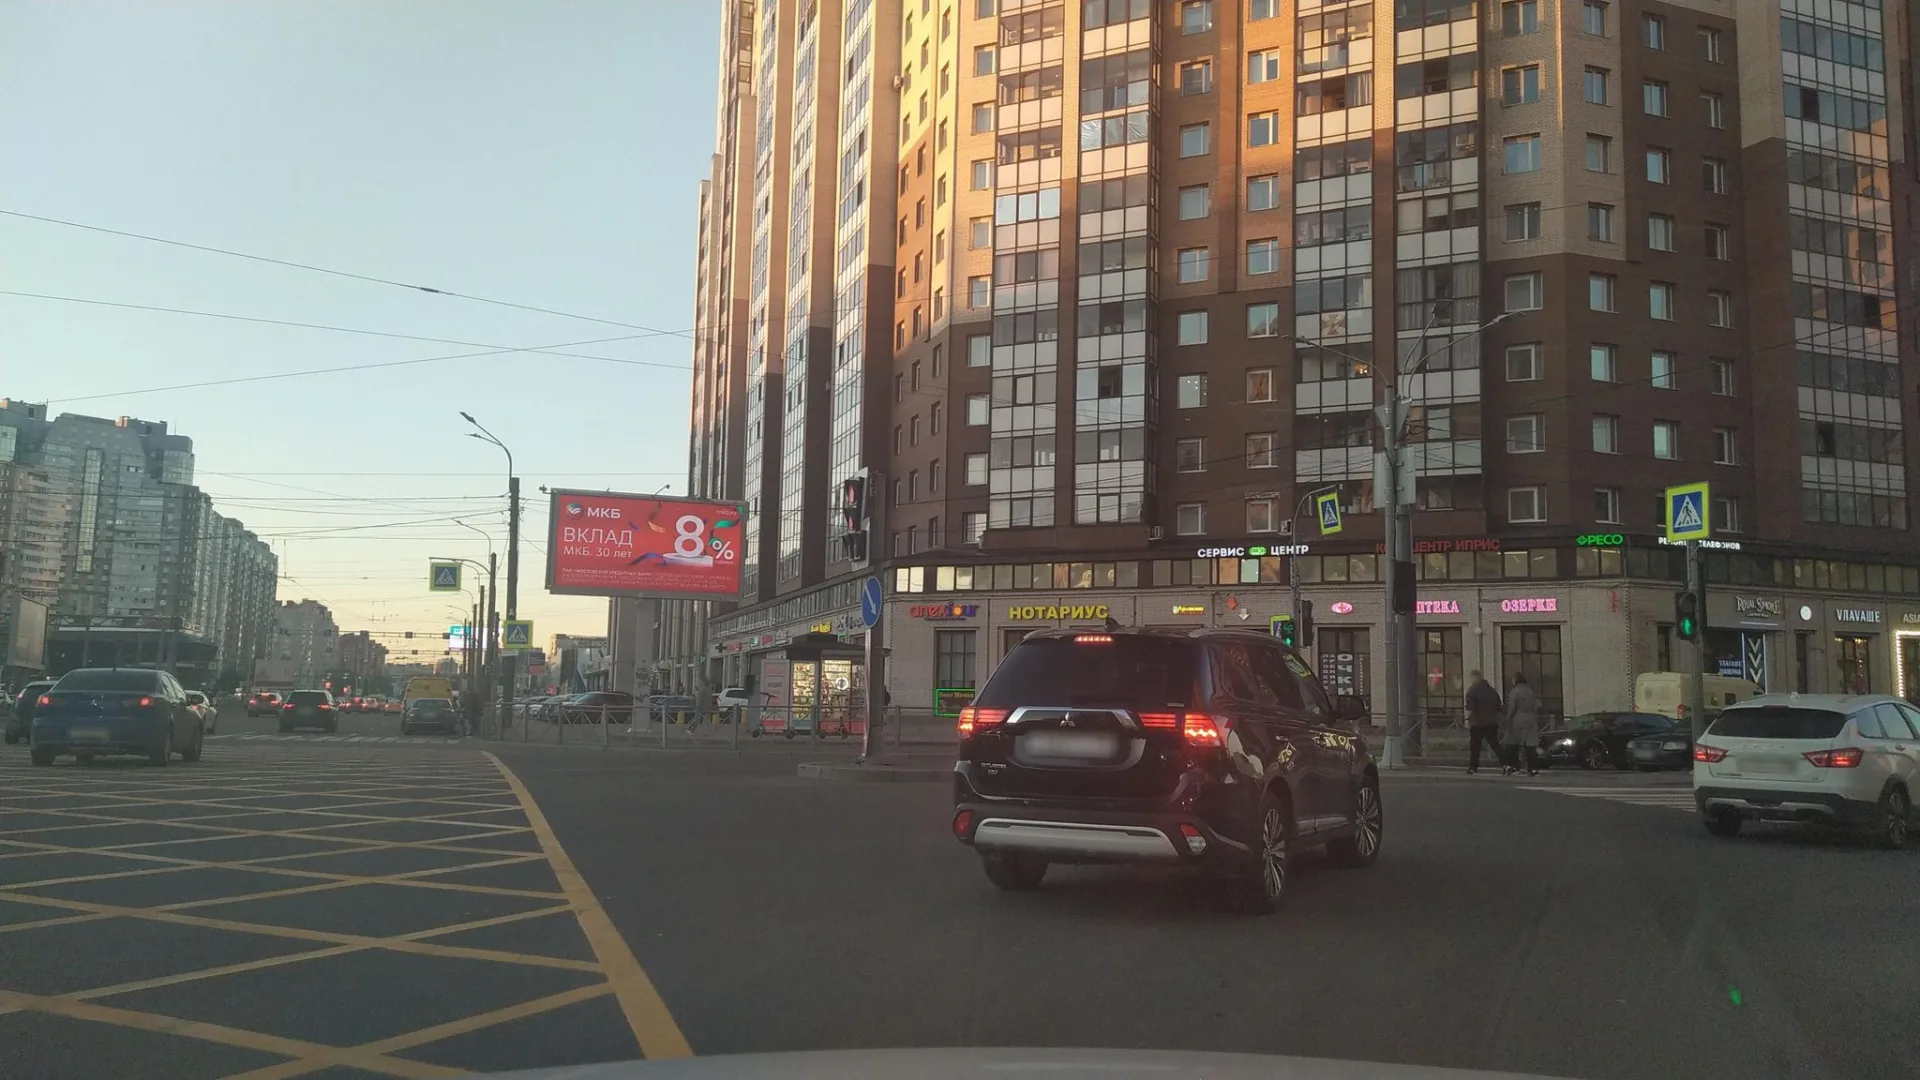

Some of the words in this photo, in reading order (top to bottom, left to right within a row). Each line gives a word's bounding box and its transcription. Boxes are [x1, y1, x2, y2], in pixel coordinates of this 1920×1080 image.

[587, 507, 621, 519] МКБ
[563, 527, 633, 548] ВКЛАД
[1197, 547, 1245, 558] СЕРВИС
[1270, 545, 1310, 556] ЦЕНТР
[1455, 539, 1501, 551] ИПРИС
[596, 548, 610, 557] 30
[613, 549, 633, 559] лет
[1415, 600, 1460, 614] ПТЕКА
[1501, 598, 1557, 612] ОЗЕРКИ
[1008, 605, 1109, 620] НОТАРИУС
